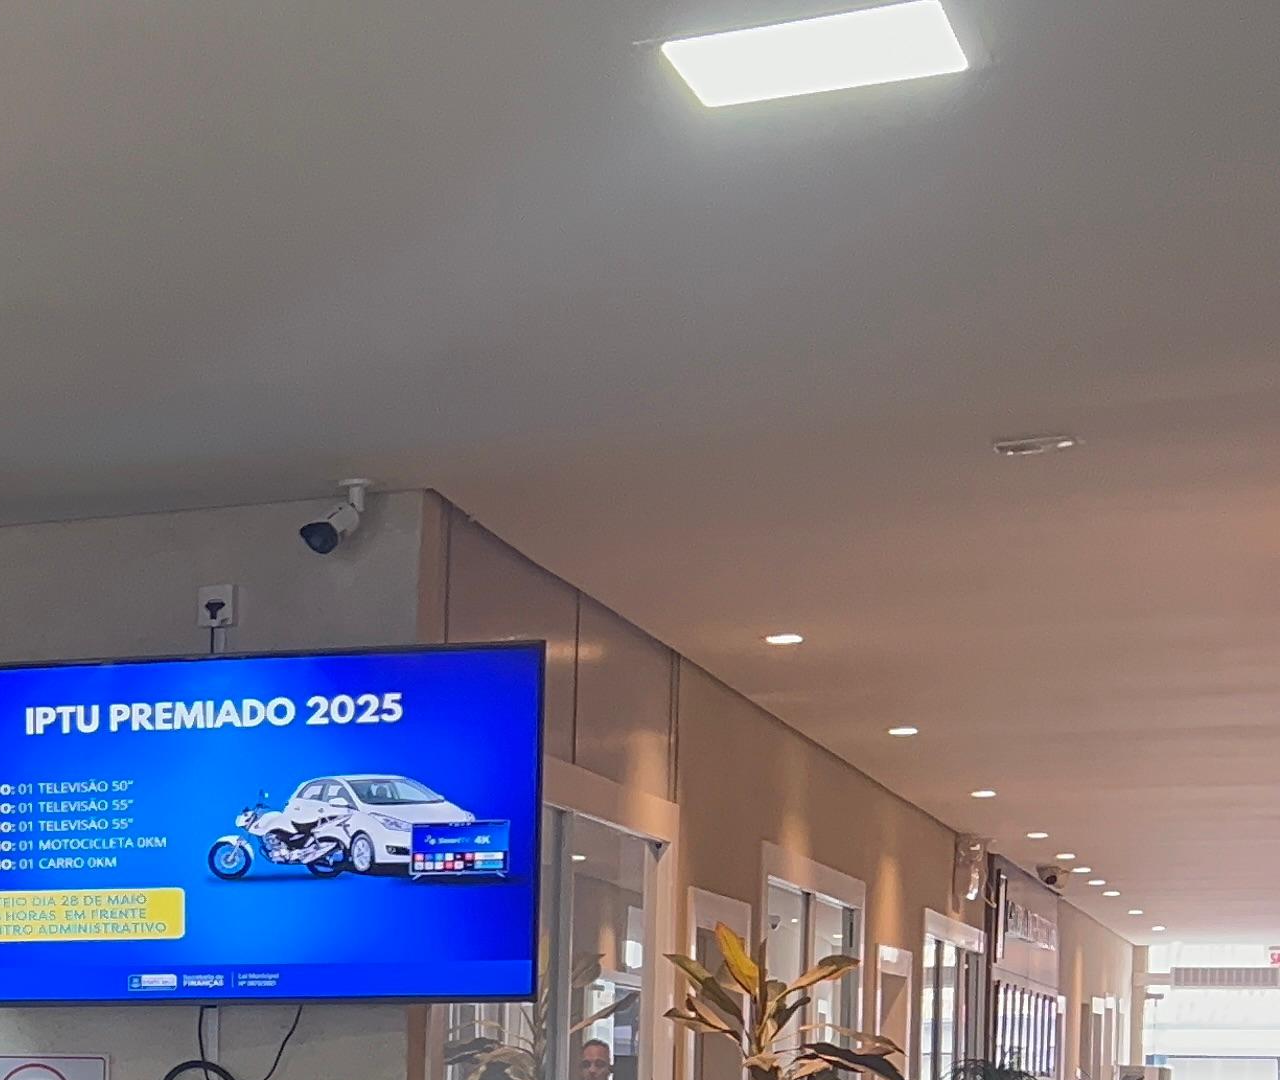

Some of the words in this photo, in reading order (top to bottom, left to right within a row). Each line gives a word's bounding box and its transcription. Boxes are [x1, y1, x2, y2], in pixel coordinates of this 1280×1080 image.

[25, 704, 99, 735] IPTU
[109, 696, 296, 732] PREMIADO
[305, 692, 403, 725] 2025
[17, 783, 33, 795] 01
[38, 779, 108, 794] TELEVISÃO
[17, 802, 33, 814] 01
[38, 798, 108, 813] TELEVISÃO
[17, 821, 33, 833] 01
[38, 816, 108, 832] TELEVISÃO
[17, 840, 33, 852] 01
[38, 837, 134, 851] MOTOCICLETA
[137, 836, 167, 848] 0KM
[17, 858, 33, 870] 01
[38, 857, 84, 870] CARRO
[87, 856, 117, 868] 0KM
[32, 896, 56, 907] DIA
[62, 895, 79, 906] 28
[83, 895, 102, 906] DE
[107, 893, 147, 905] MAIO
[5, 910, 56, 921] HORAS
[65, 909, 87, 920] EM
[91, 908, 146, 920] FRENTE
[38, 921, 167, 935] ADMINISTRATIVO
